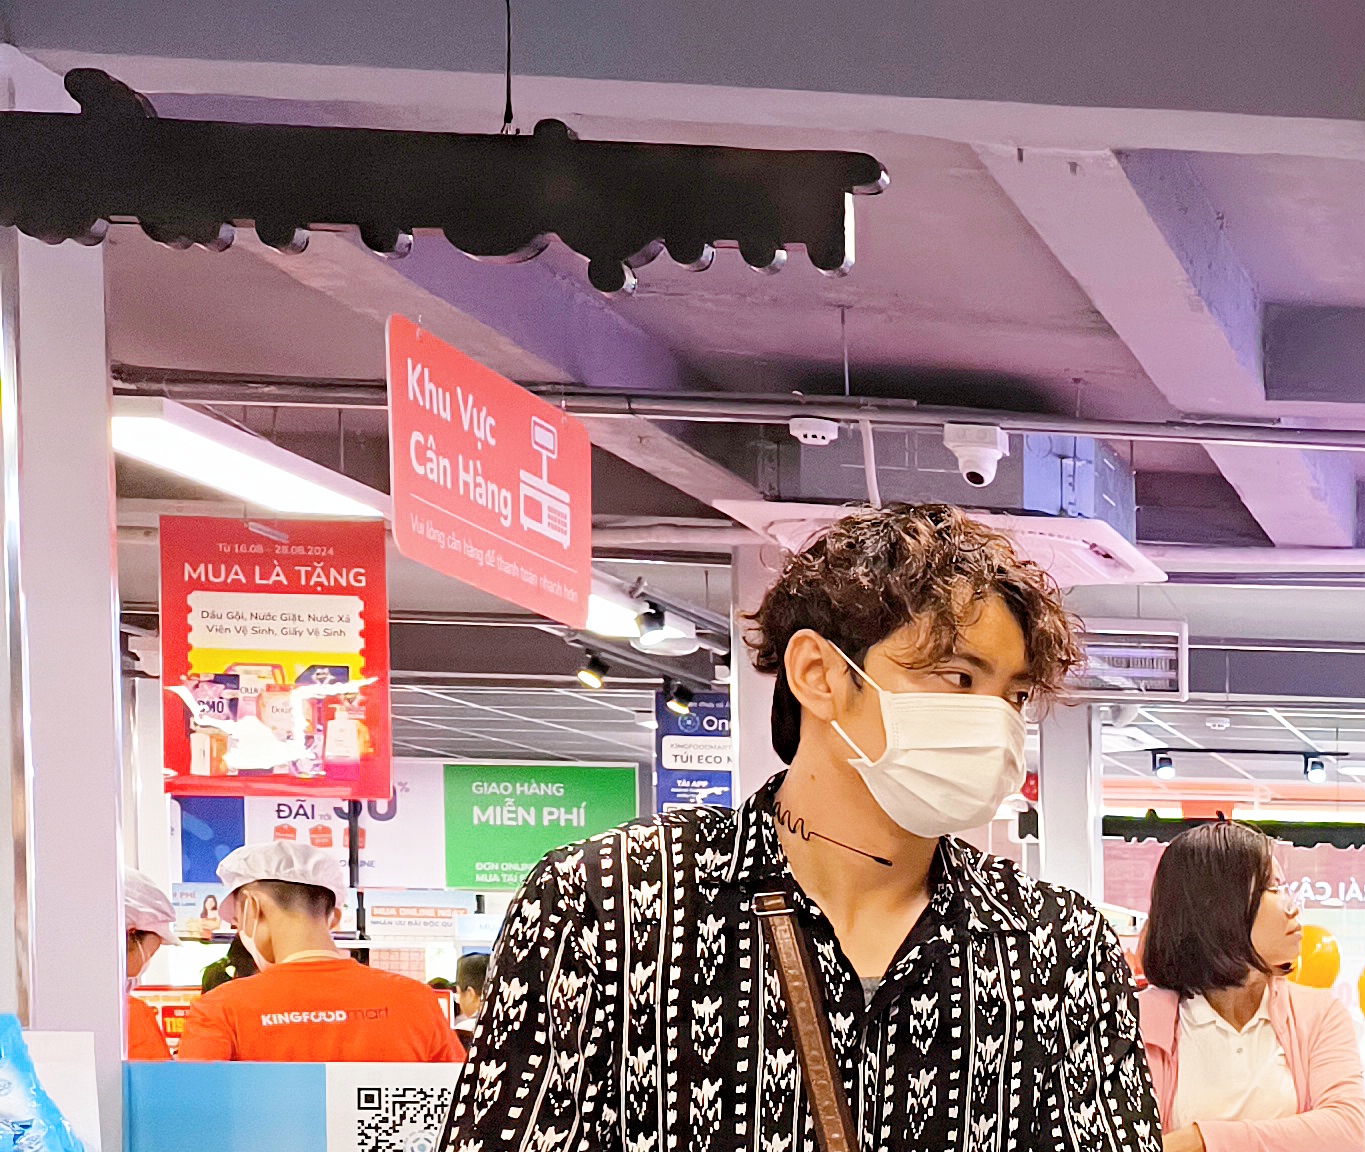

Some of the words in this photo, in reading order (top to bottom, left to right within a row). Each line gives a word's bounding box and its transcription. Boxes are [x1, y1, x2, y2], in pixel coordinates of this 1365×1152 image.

[407, 357, 451, 422] Khu
[456, 385, 497, 450] Vực
[409, 430, 452, 490] Cân
[458, 453, 513, 528] Hàng
[183, 562, 247, 585] MUA
[254, 560, 288, 586] LÀ
[294, 561, 367, 591] TẶNG
[671, 751, 693, 764] TÚI
[697, 754, 723, 765] ECO
[471, 782, 513, 796] GIAO
[515, 778, 565, 797] HÀNG
[275, 795, 317, 821] ĐÃI
[472, 798, 536, 827] MIỄN
[541, 801, 587, 827] PHÍ
